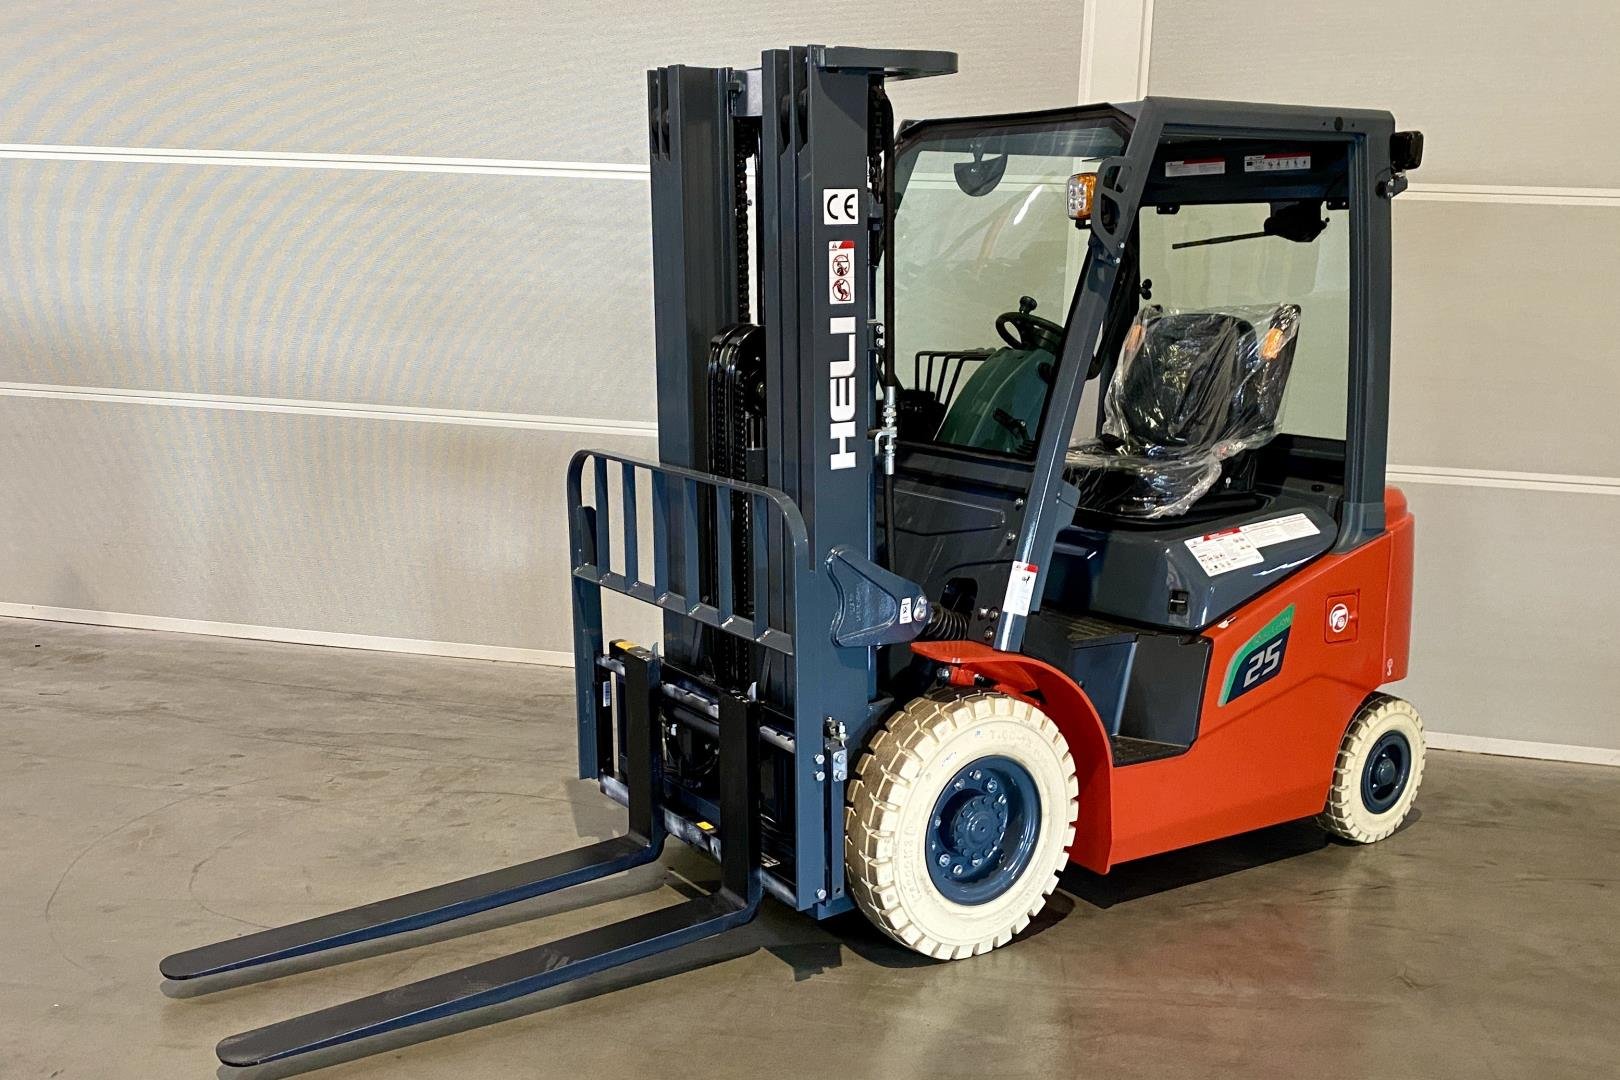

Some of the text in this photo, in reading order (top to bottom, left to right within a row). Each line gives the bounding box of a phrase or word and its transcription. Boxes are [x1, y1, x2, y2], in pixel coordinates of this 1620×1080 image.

[827, 194, 856, 220] CE
[830, 317, 856, 470] HELI
[1243, 638, 1283, 688] 25
